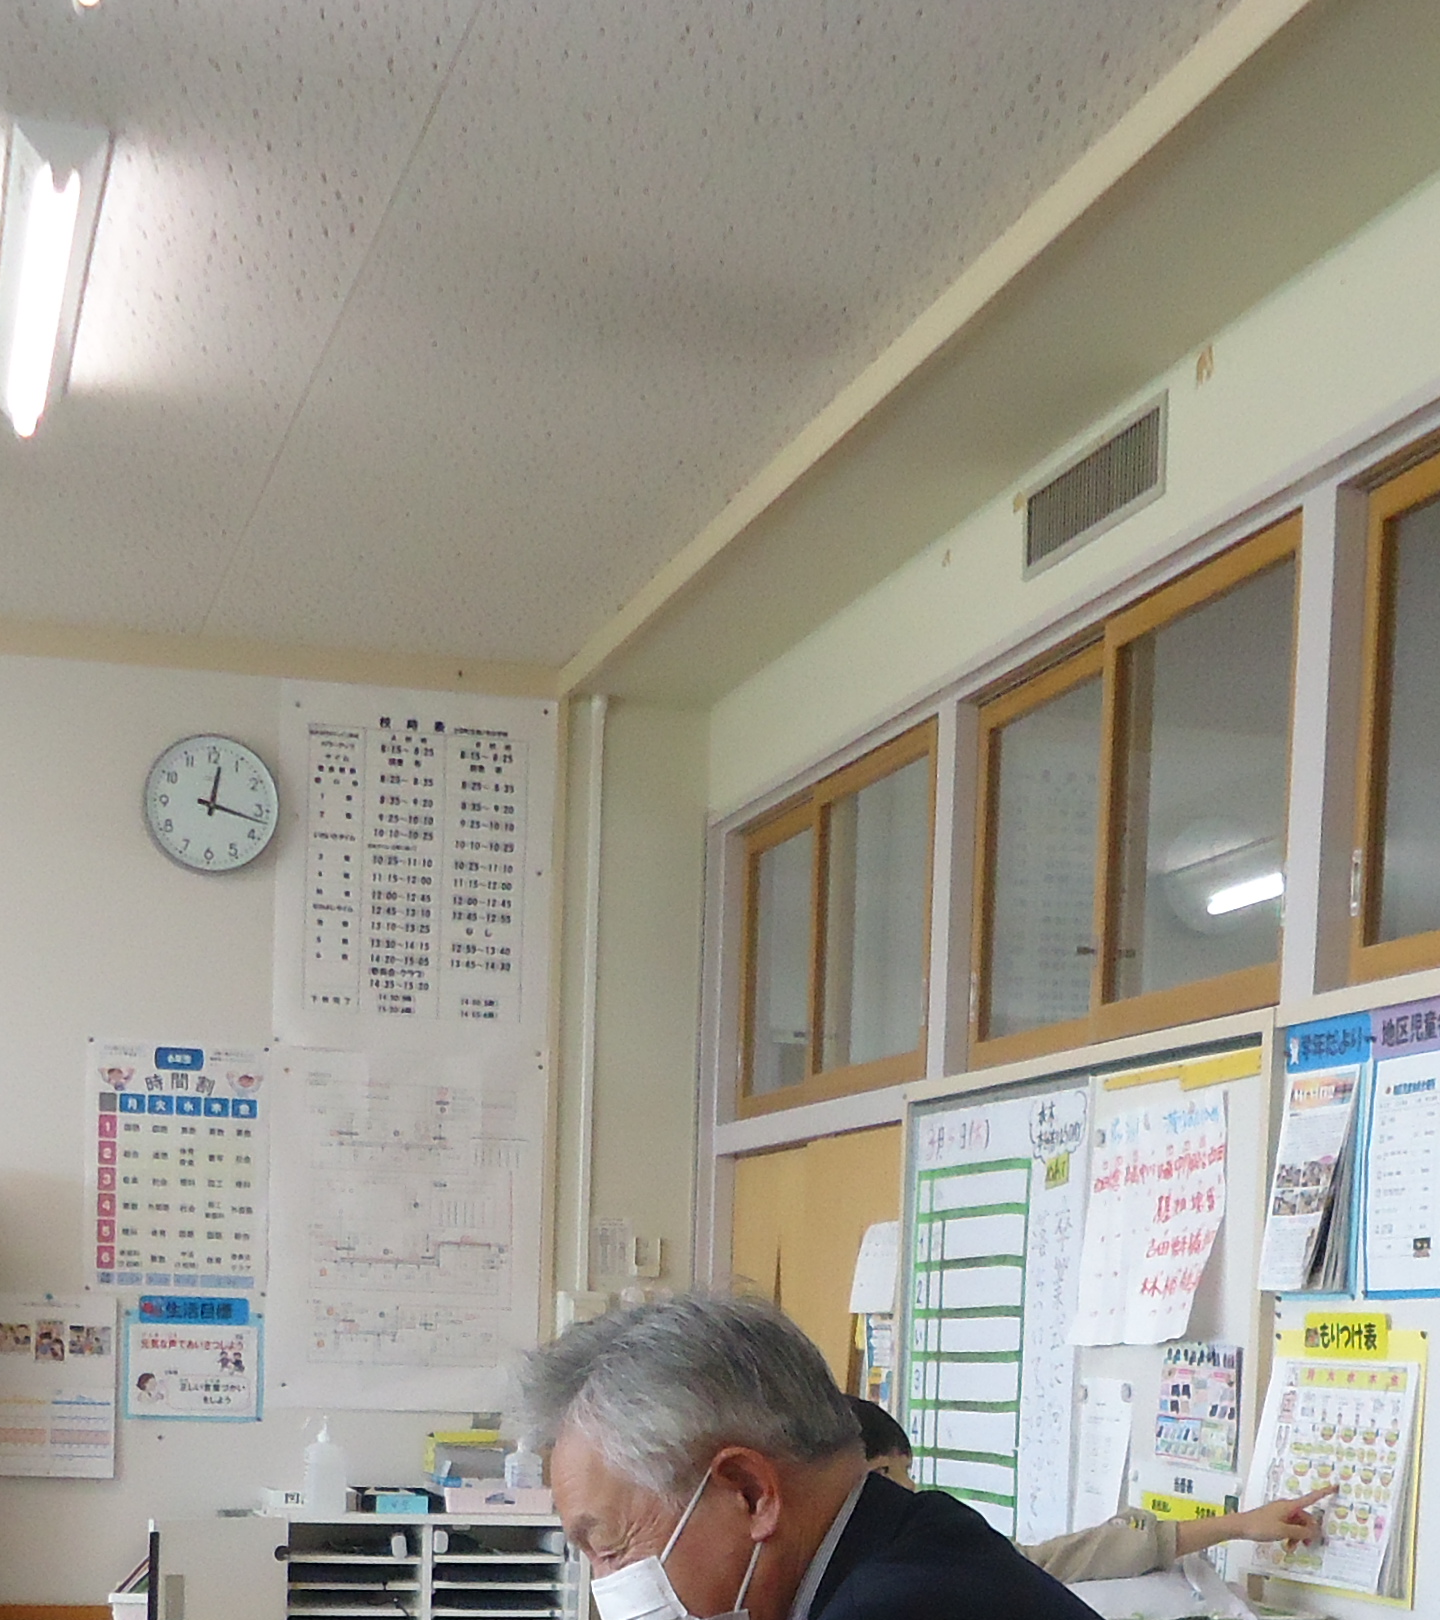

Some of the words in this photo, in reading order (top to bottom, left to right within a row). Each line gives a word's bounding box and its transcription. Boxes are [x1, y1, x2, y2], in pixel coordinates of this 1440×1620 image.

[186, 755, 194, 768] 11
[207, 750, 221, 765] 12
[166, 771, 178, 784] 10
[249, 777, 259, 791] 2
[159, 794, 170, 807] 9
[253, 803, 264, 818] 3
[163, 818, 174, 833] 8
[247, 828, 256, 840] 4
[181, 838, 191, 851] 7
[228, 842, 239, 857] 5
[203, 847, 214, 861] 6
[145, 1072, 216, 1096] 時間割
[1319, 1322, 1378, 1351] もりつけ表
